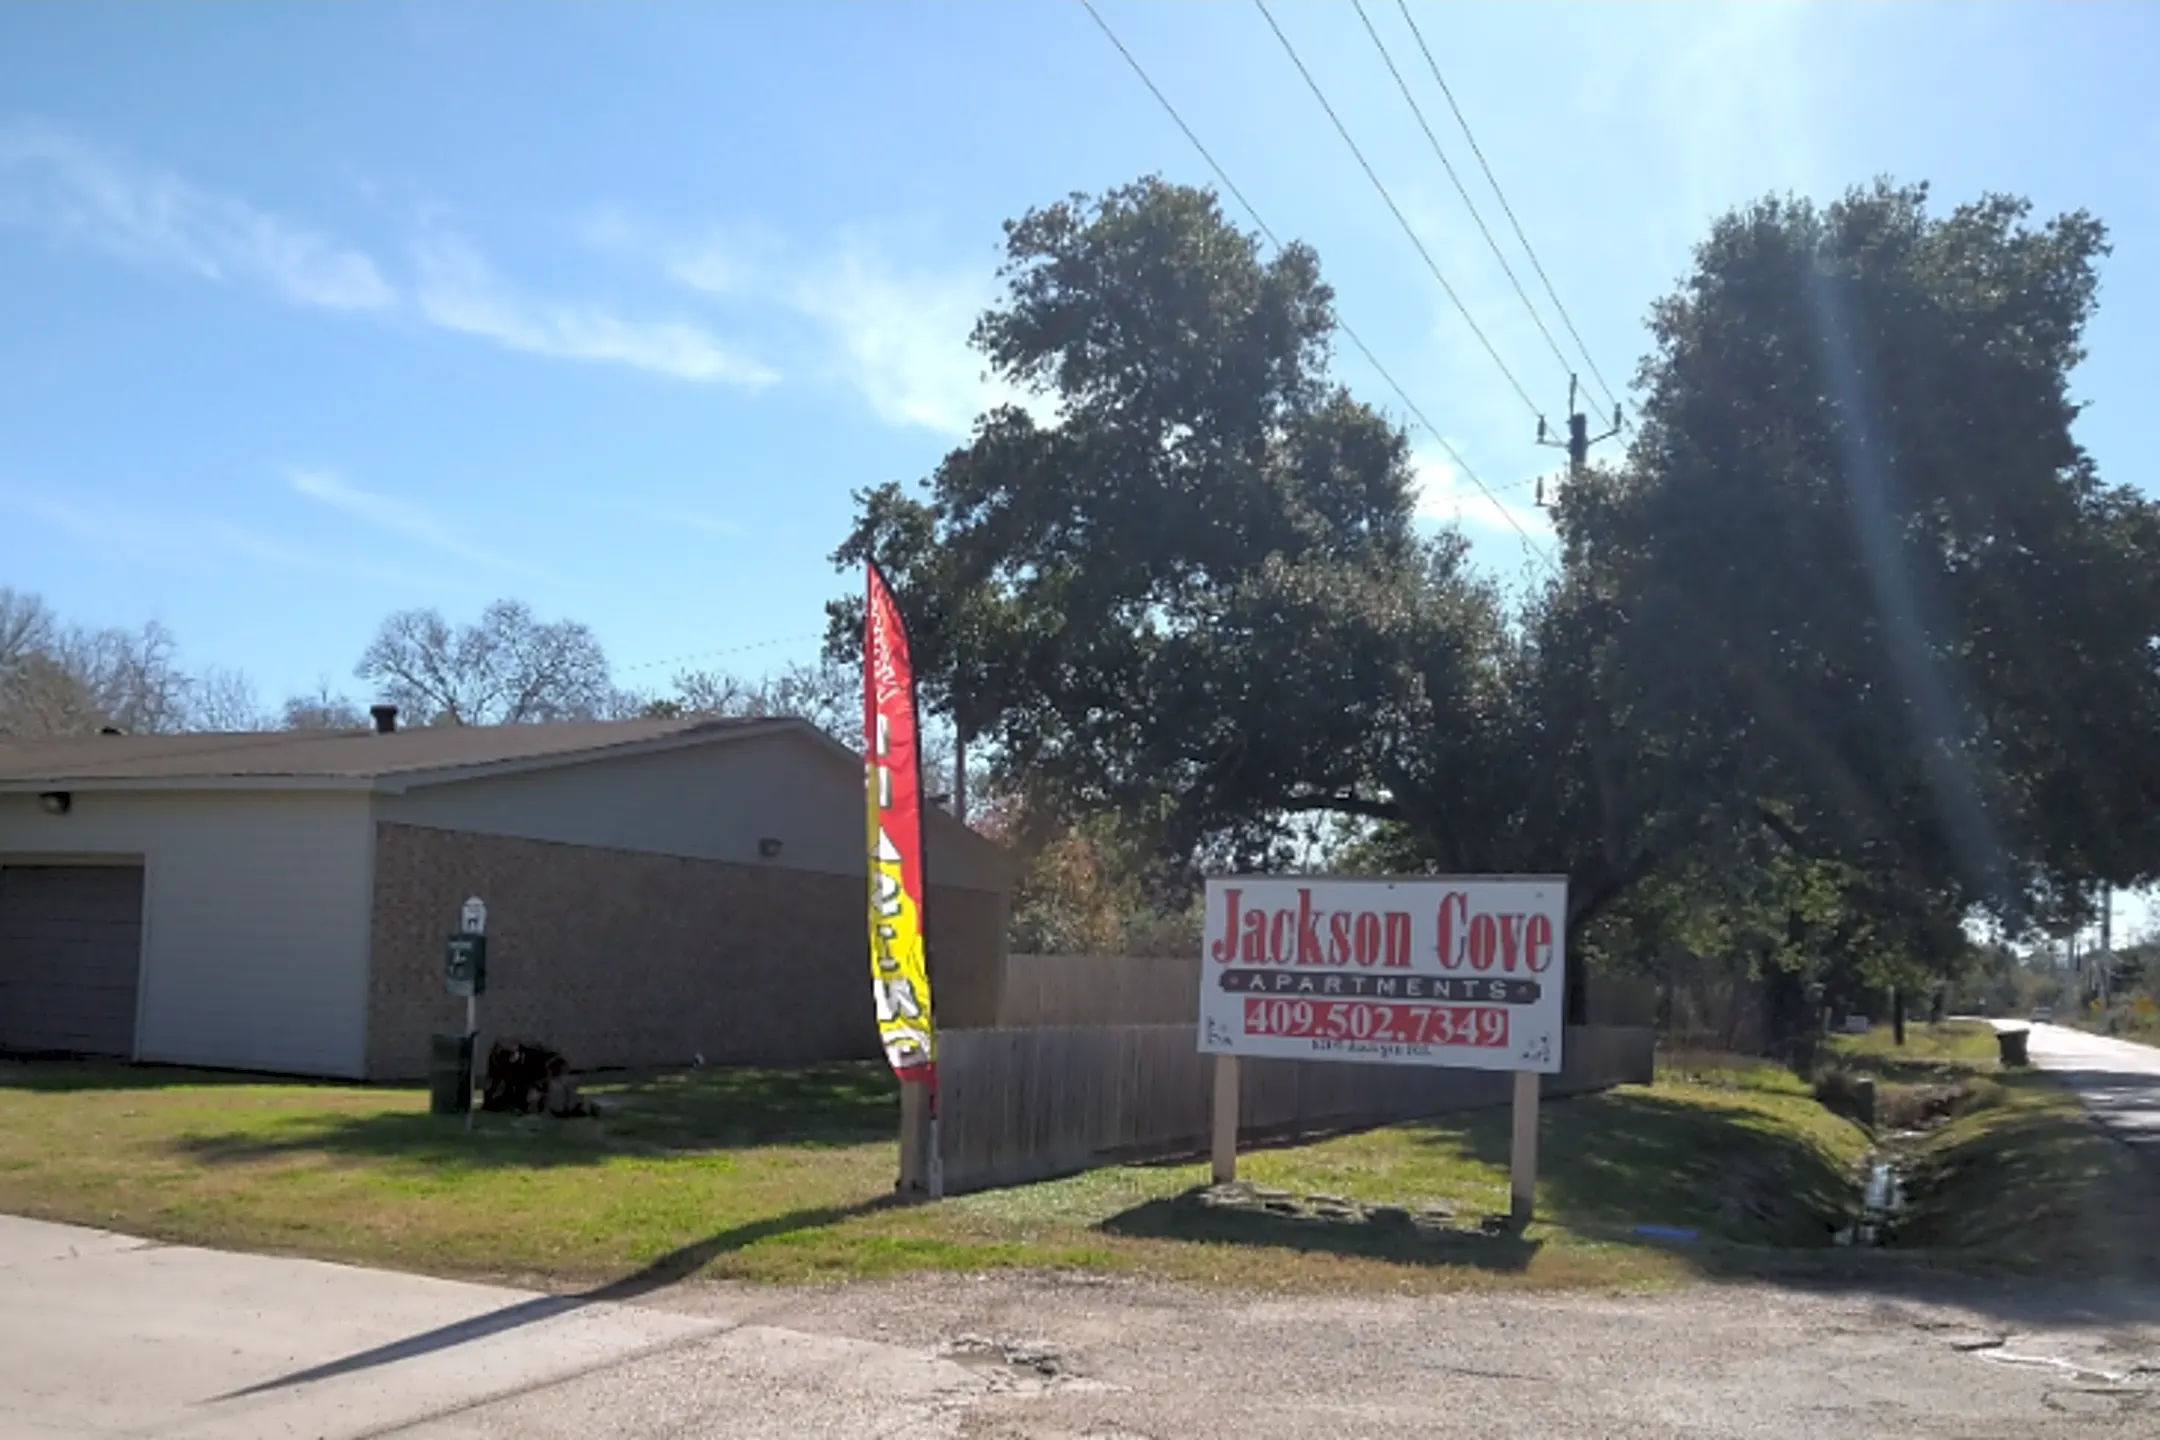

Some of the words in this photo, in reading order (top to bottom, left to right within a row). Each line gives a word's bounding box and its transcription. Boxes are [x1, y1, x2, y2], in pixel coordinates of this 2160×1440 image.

[1211, 888, 1412, 966] Jackson
[1435, 891, 1553, 973] Cove
[1249, 974, 1508, 999] APARTMENTS
[1246, 1001, 1504, 1044] 409.502.7349
